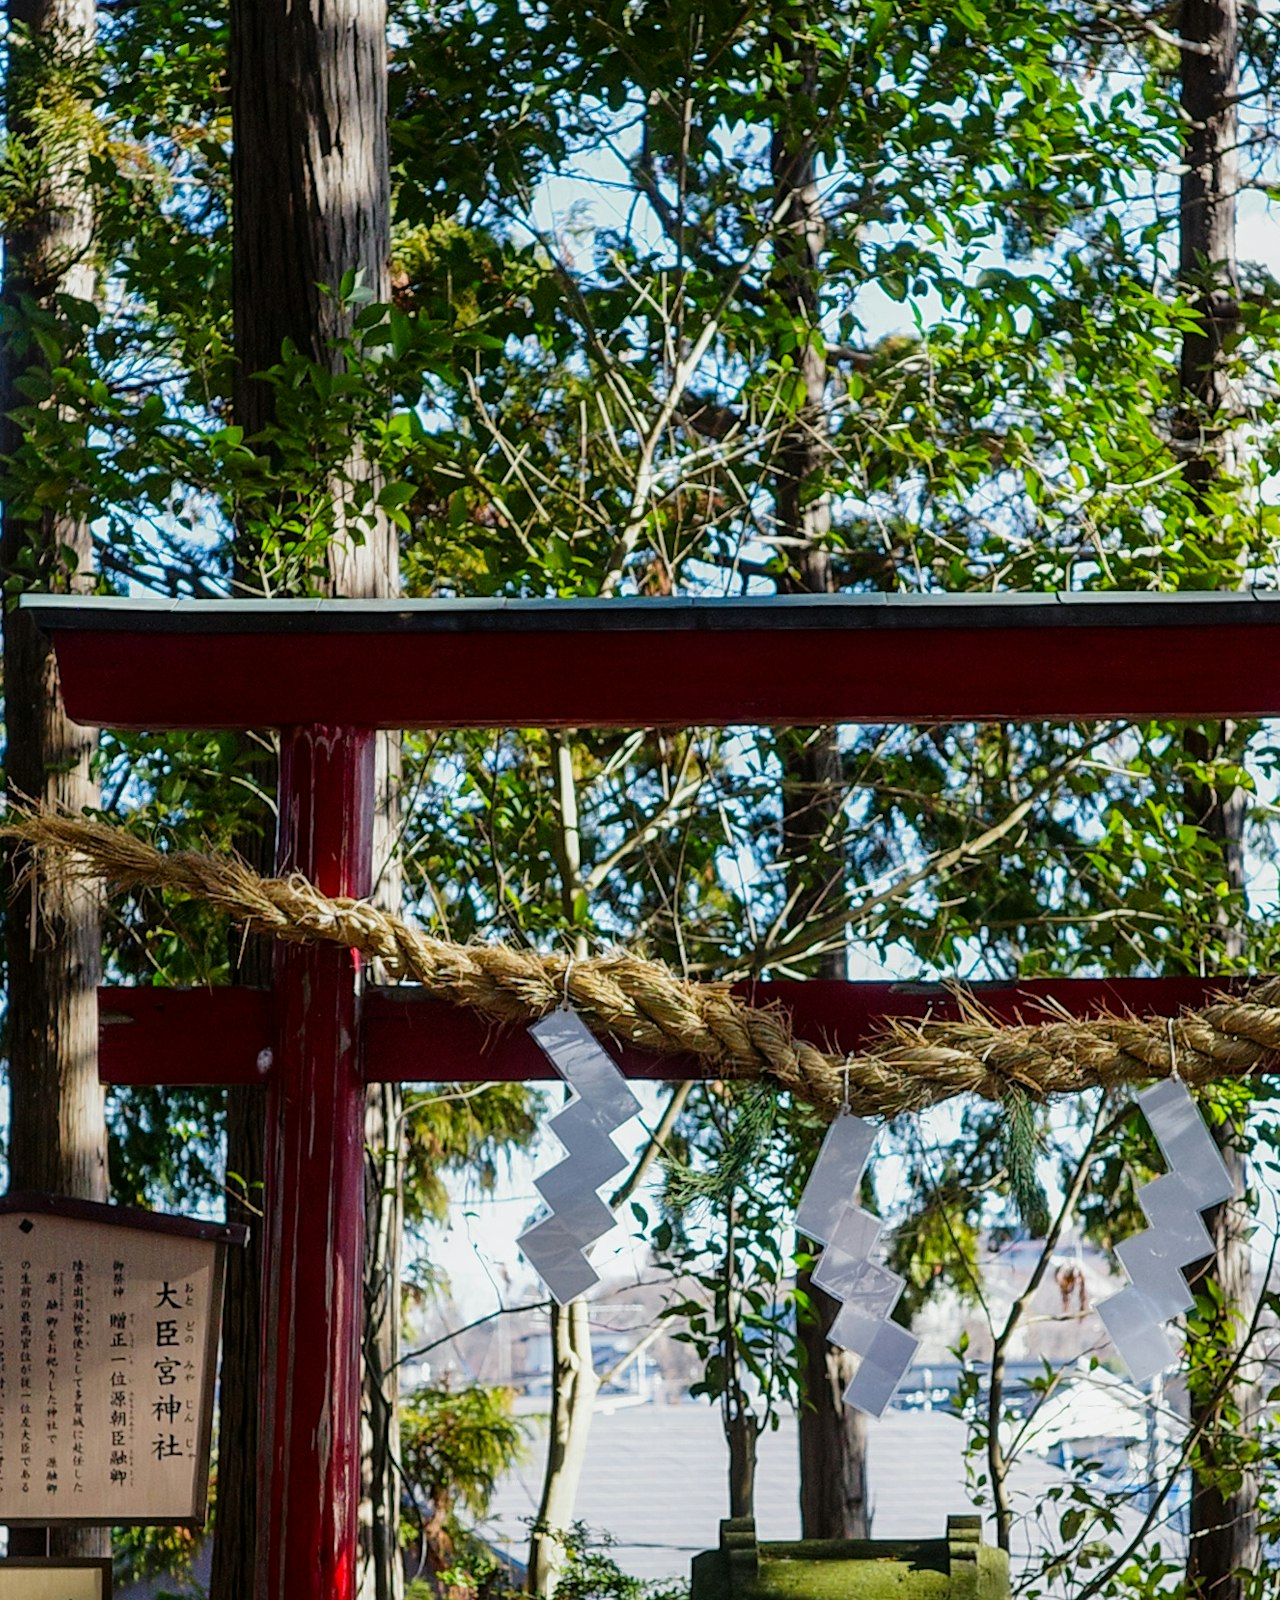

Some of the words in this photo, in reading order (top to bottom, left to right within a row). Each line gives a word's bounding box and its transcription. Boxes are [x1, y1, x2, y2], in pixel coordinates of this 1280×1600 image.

[151, 1281, 182, 1460] 大臣宮神社
